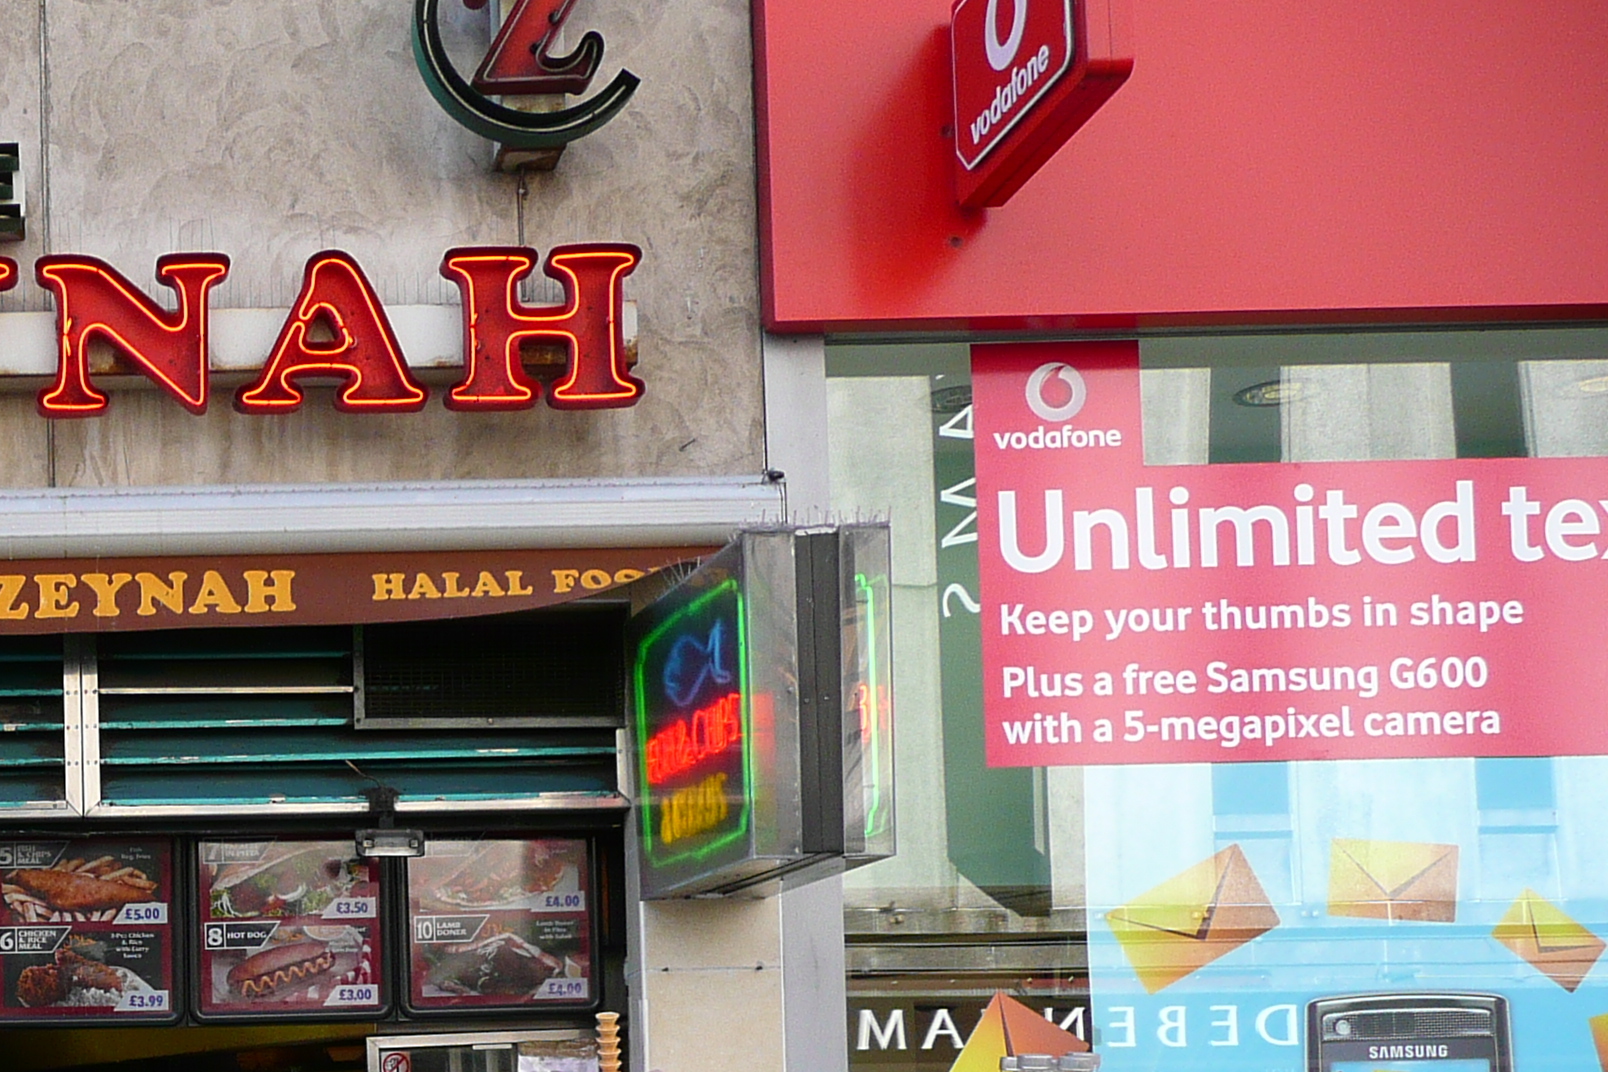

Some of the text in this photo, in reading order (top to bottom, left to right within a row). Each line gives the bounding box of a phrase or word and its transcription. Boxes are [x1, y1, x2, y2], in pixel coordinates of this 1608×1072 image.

[971, 45, 1049, 145] vodafone
[993, 424, 1122, 450] vodafone
[997, 480, 1476, 574] Unlimited
[1502, 486, 1608, 564] te
[371, 565, 660, 600] HALAL FOO
[999, 595, 1525, 641] Keep your thumbs in shape
[1002, 656, 1489, 699] Plus a free Samsung G600
[1002, 706, 1502, 749] with a 5-megapixel camera
[336, 902, 369, 915] £3.50
[545, 894, 581, 908] £4.00
[124, 907, 161, 921] £5.00
[0, 929, 57, 951] 6 CHICKEN
[207, 927, 268, 947] 8 HOT DOG
[417, 920, 461, 940] 10 LAMB
[128, 995, 164, 1009] £3.99
[339, 988, 372, 1002] £3.00
[1368, 1043, 1449, 1060] SAMSUNG
